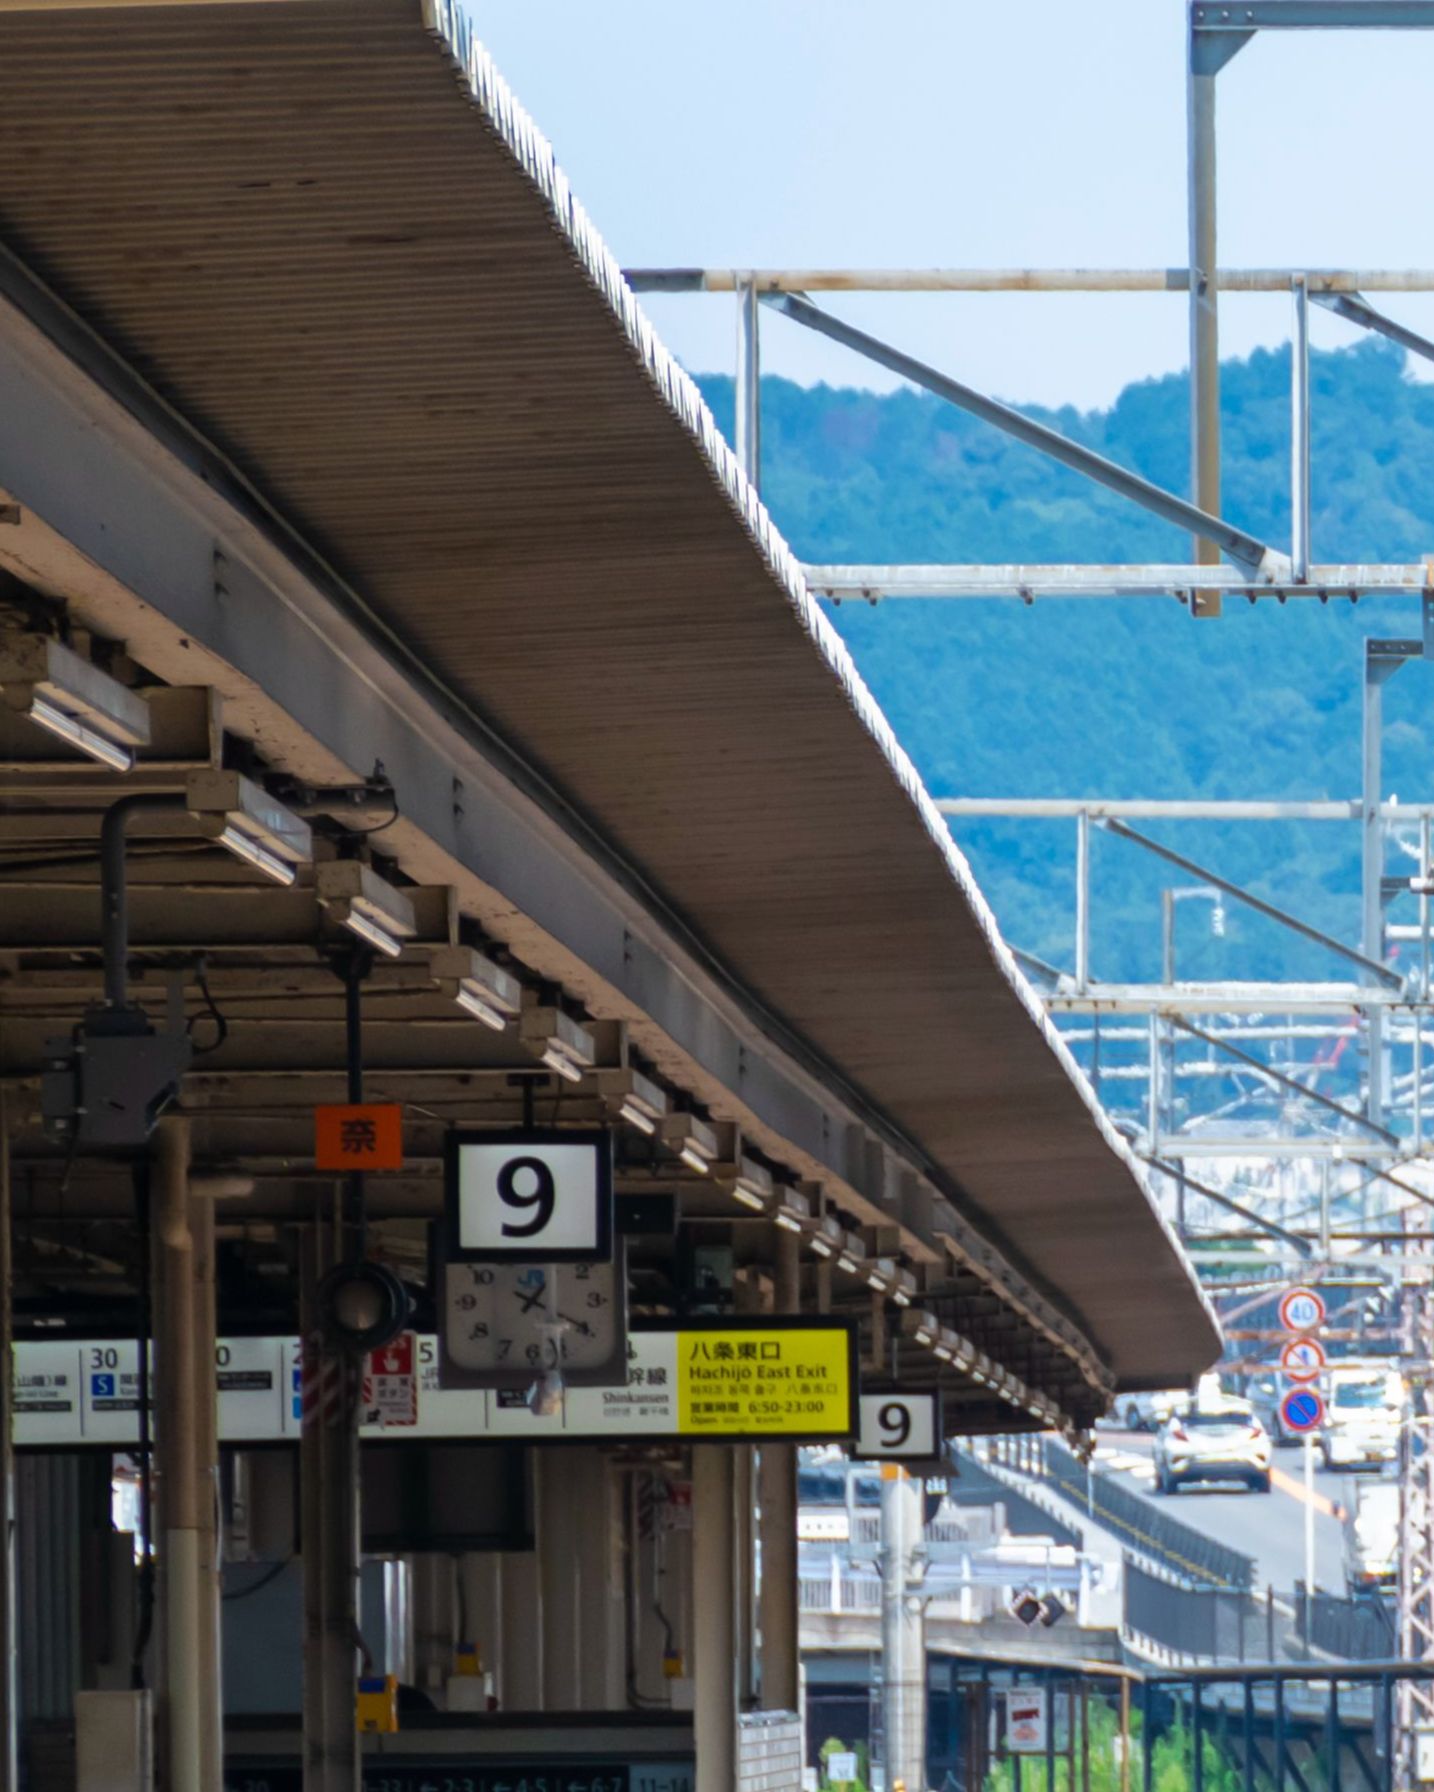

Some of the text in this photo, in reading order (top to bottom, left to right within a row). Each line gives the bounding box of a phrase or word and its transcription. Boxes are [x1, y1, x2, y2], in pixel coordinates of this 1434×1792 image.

[341, 1119, 376, 1153] 奈
[496, 1155, 555, 1239] 9
[90, 1347, 118, 1369] 30
[689, 1341, 781, 1361] 八条東口
[757, 1365, 791, 1379] East
[796, 1364, 827, 1379] Exit
[878, 1402, 911, 1449] 9
